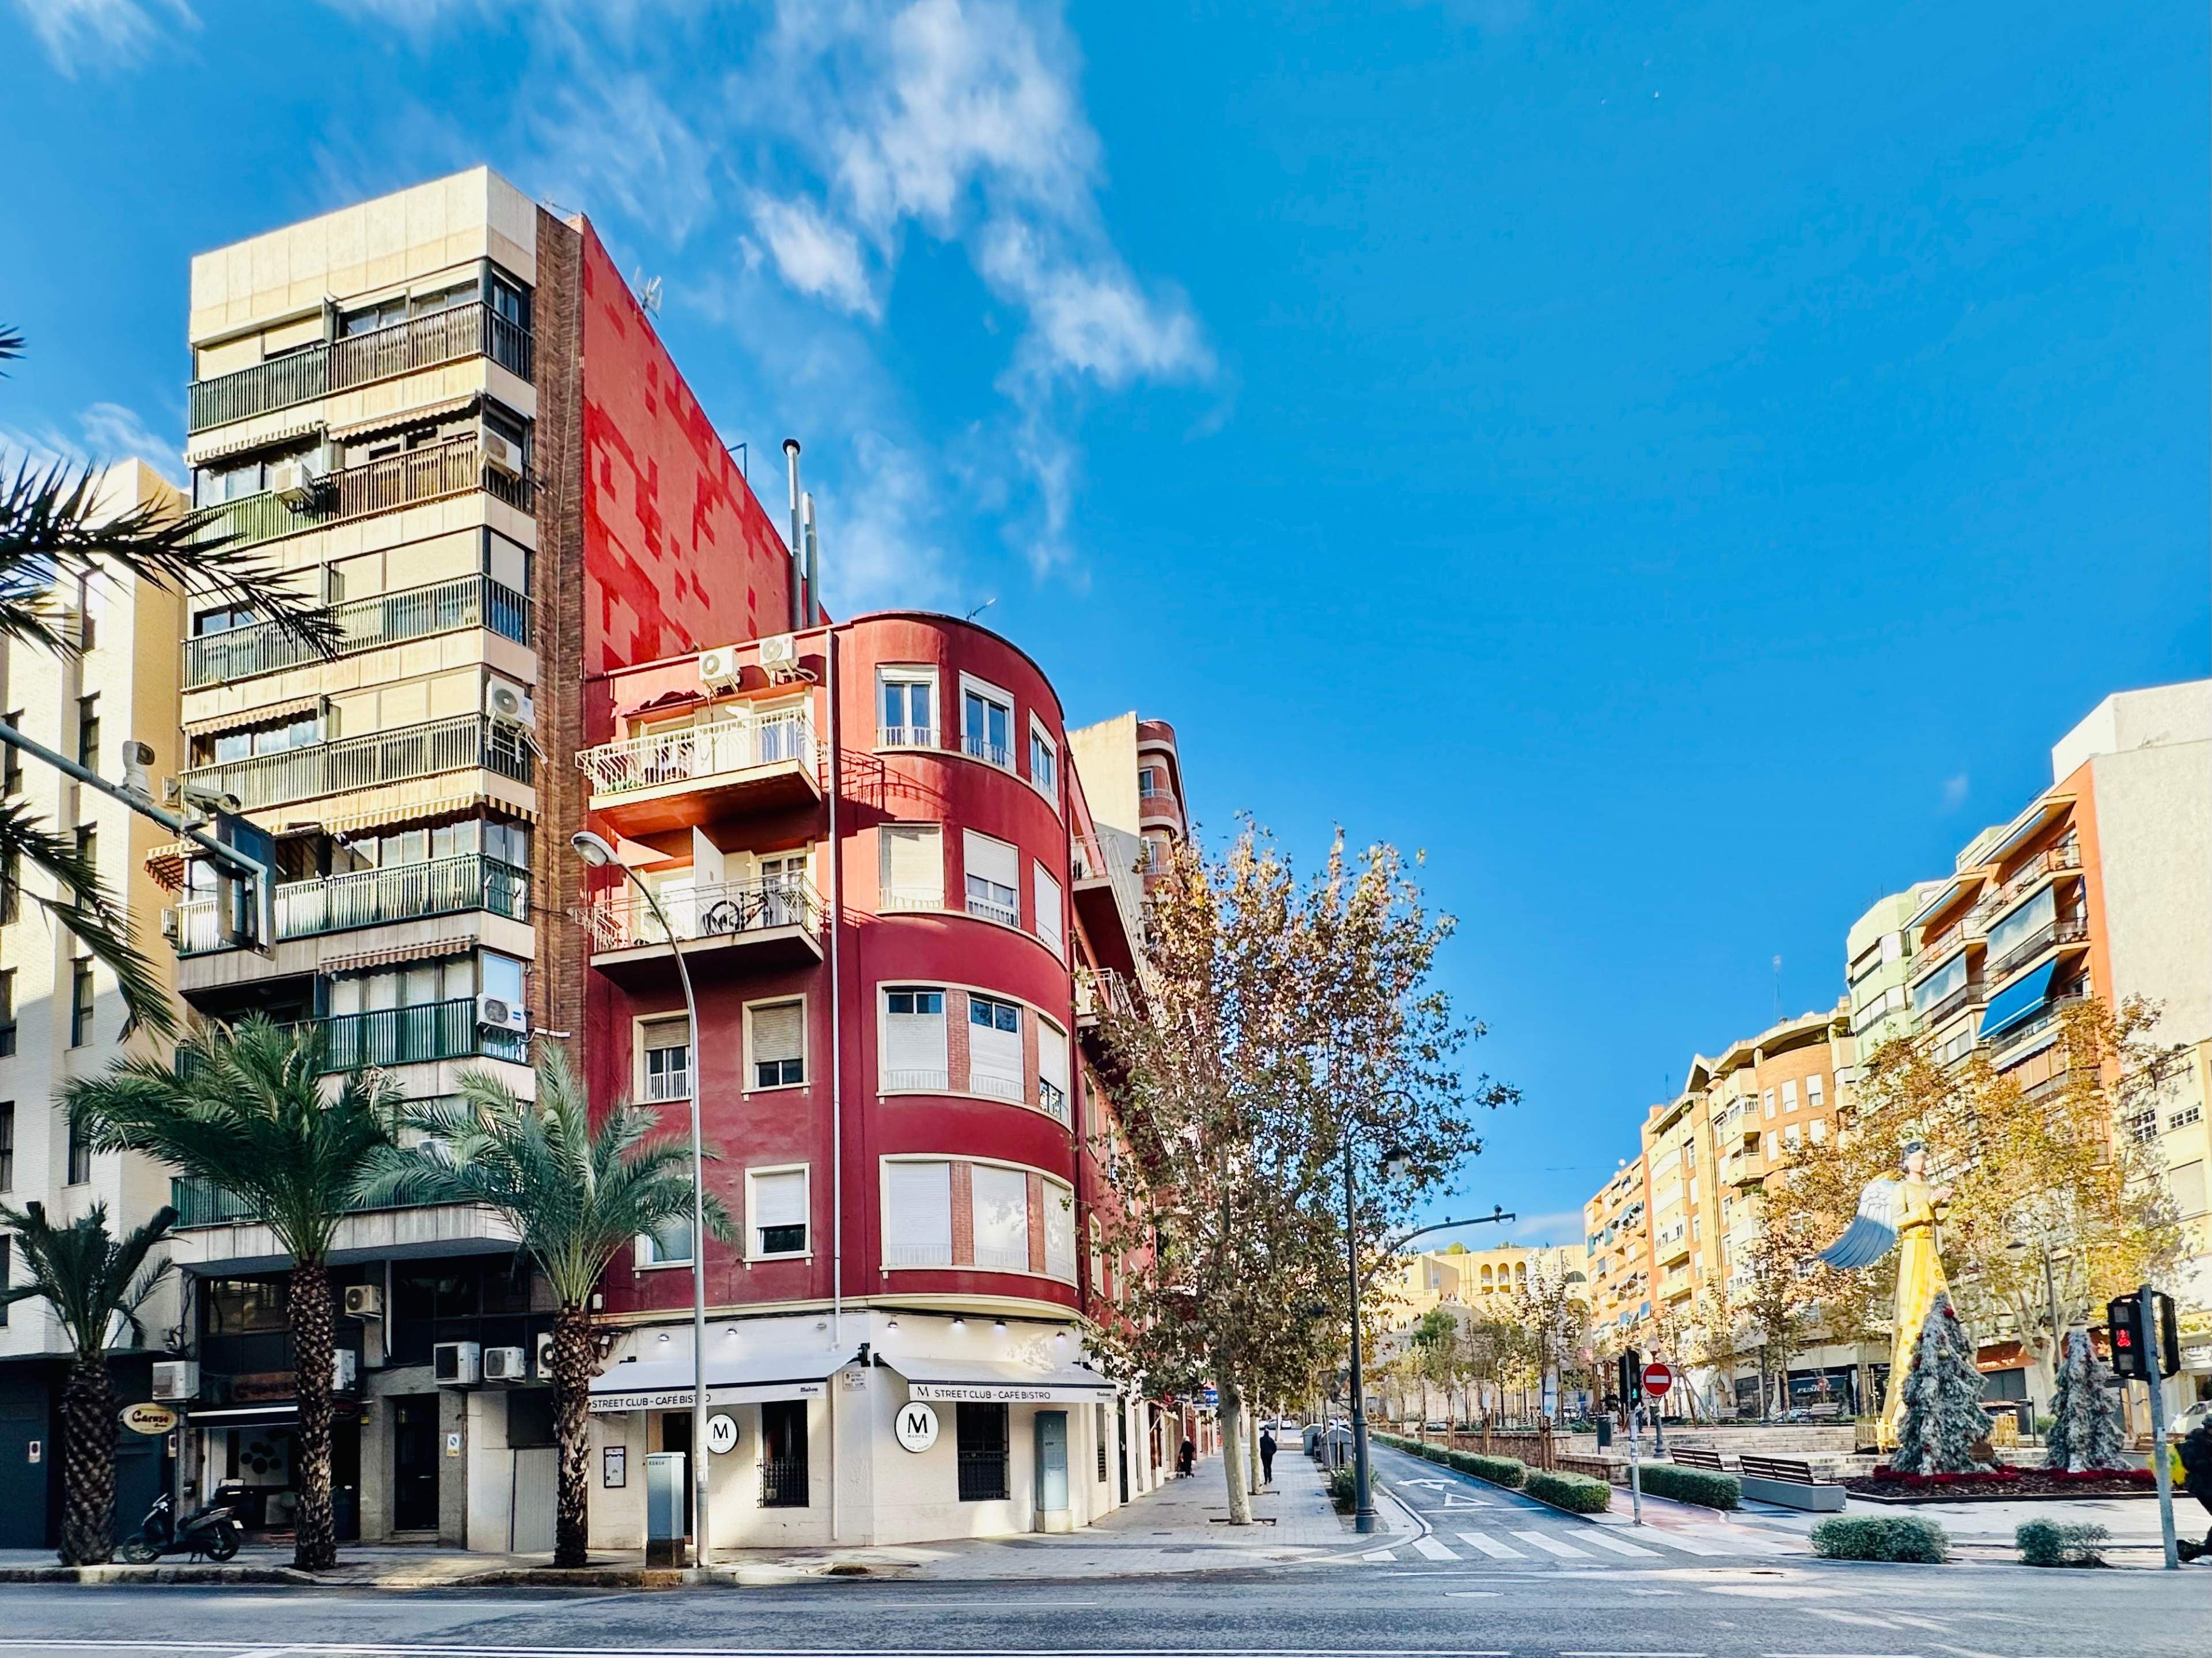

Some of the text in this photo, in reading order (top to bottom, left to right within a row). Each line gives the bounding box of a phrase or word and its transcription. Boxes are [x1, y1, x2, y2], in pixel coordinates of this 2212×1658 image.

[917, 1386, 929, 1397] M
[935, 1390, 967, 1398] STREET
[969, 1391, 991, 1399] CLUB
[592, 1399, 624, 1408] STREET
[626, 1398, 648, 1406] CLUB
[656, 1394, 678, 1405] CAFÉ
[908, 1413, 927, 1433] M
[714, 1423, 728, 1439] M
